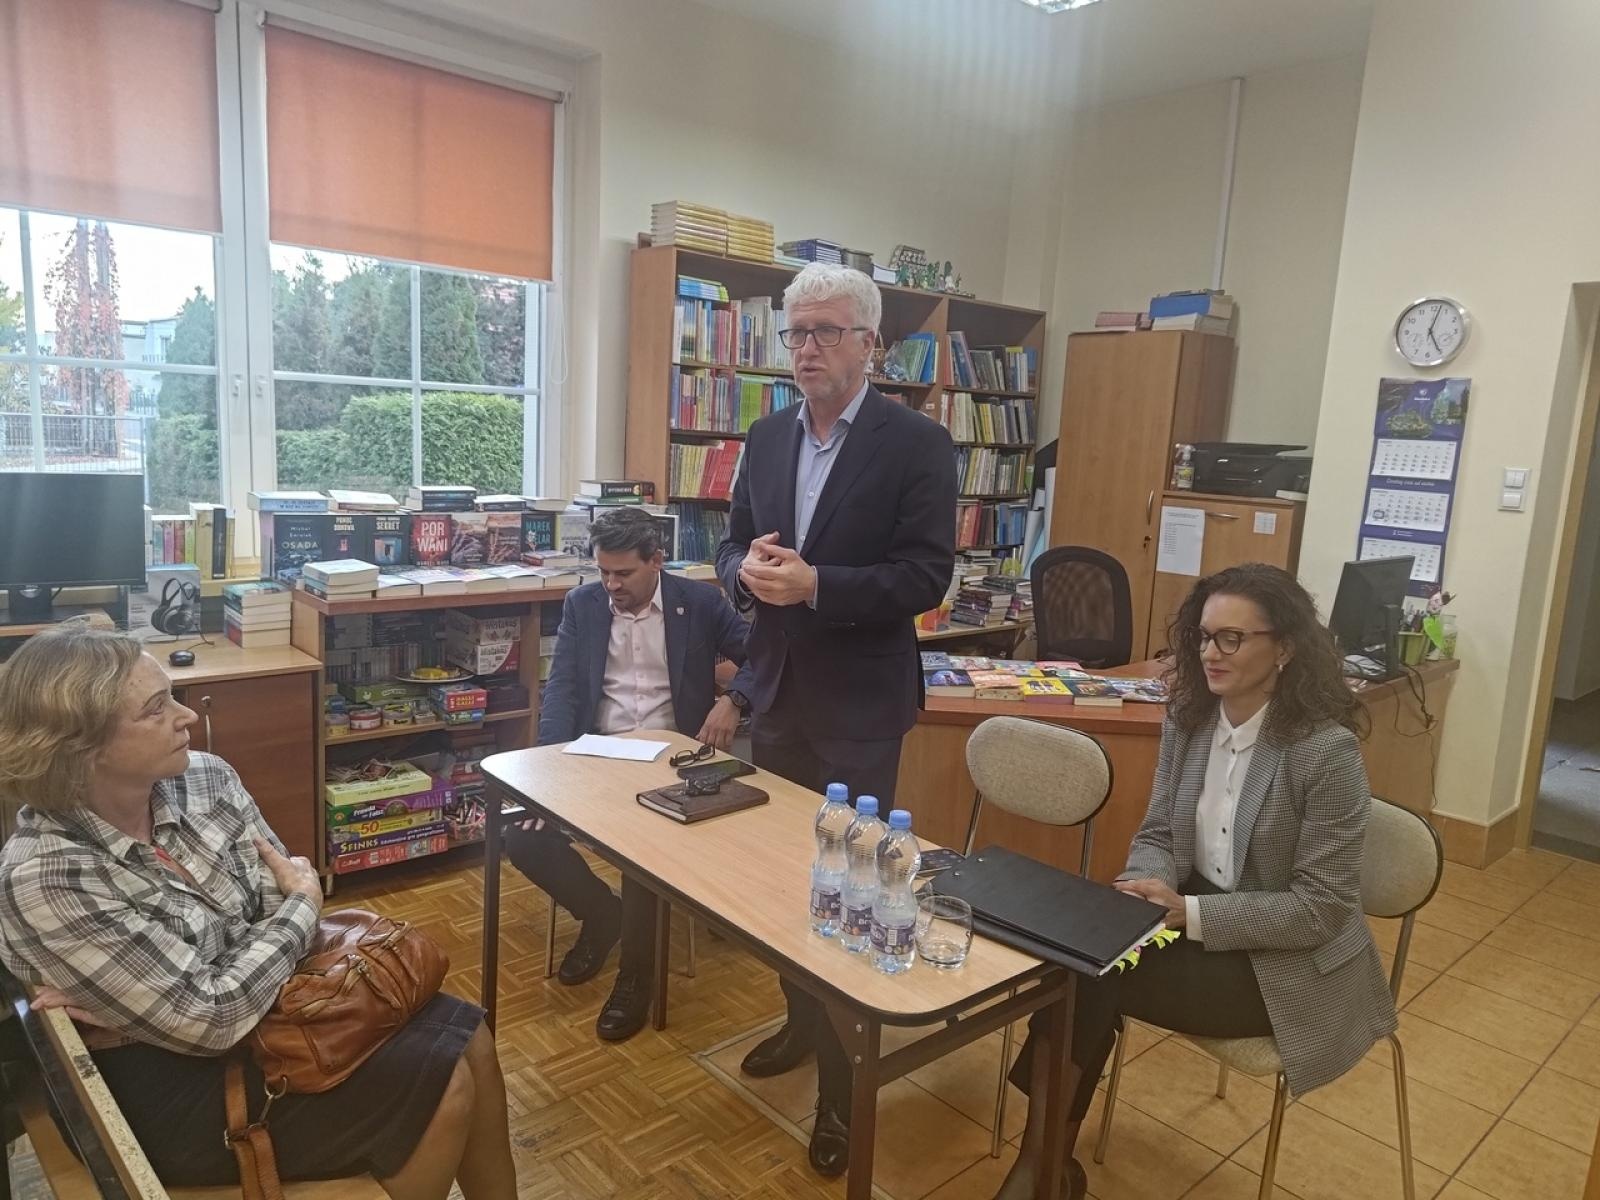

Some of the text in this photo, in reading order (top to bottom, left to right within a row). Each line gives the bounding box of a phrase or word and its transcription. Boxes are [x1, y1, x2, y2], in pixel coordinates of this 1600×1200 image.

[376, 522, 400, 531] SEKRET
[421, 521, 445, 536] POR
[525, 520, 551, 532] MAREK
[282, 541, 319, 549] OSADA
[416, 537, 448, 552] WANI
[360, 821, 380, 834] 50
[340, 839, 379, 853] SFINKS
